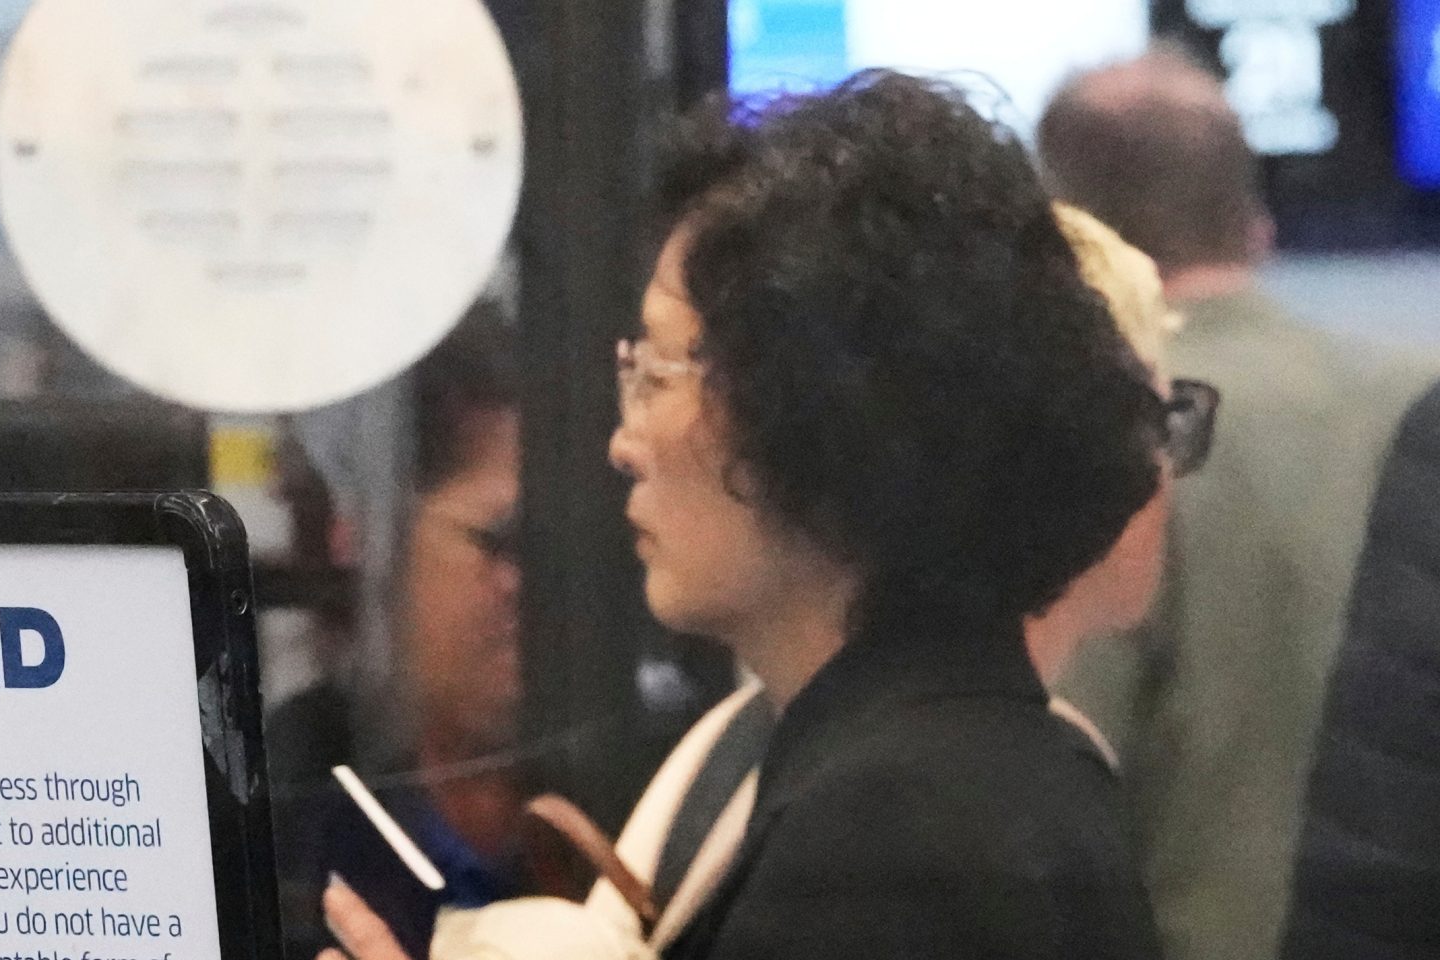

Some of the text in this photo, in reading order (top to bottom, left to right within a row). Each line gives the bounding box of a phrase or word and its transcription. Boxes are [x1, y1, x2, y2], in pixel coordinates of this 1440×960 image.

[44, 772, 140, 807] through
[9, 817, 33, 845] to
[42, 817, 161, 847] additional
[16, 906, 47, 935] do
[55, 908, 94, 936] not
[101, 907, 160, 937] have
[169, 915, 182, 937] a
